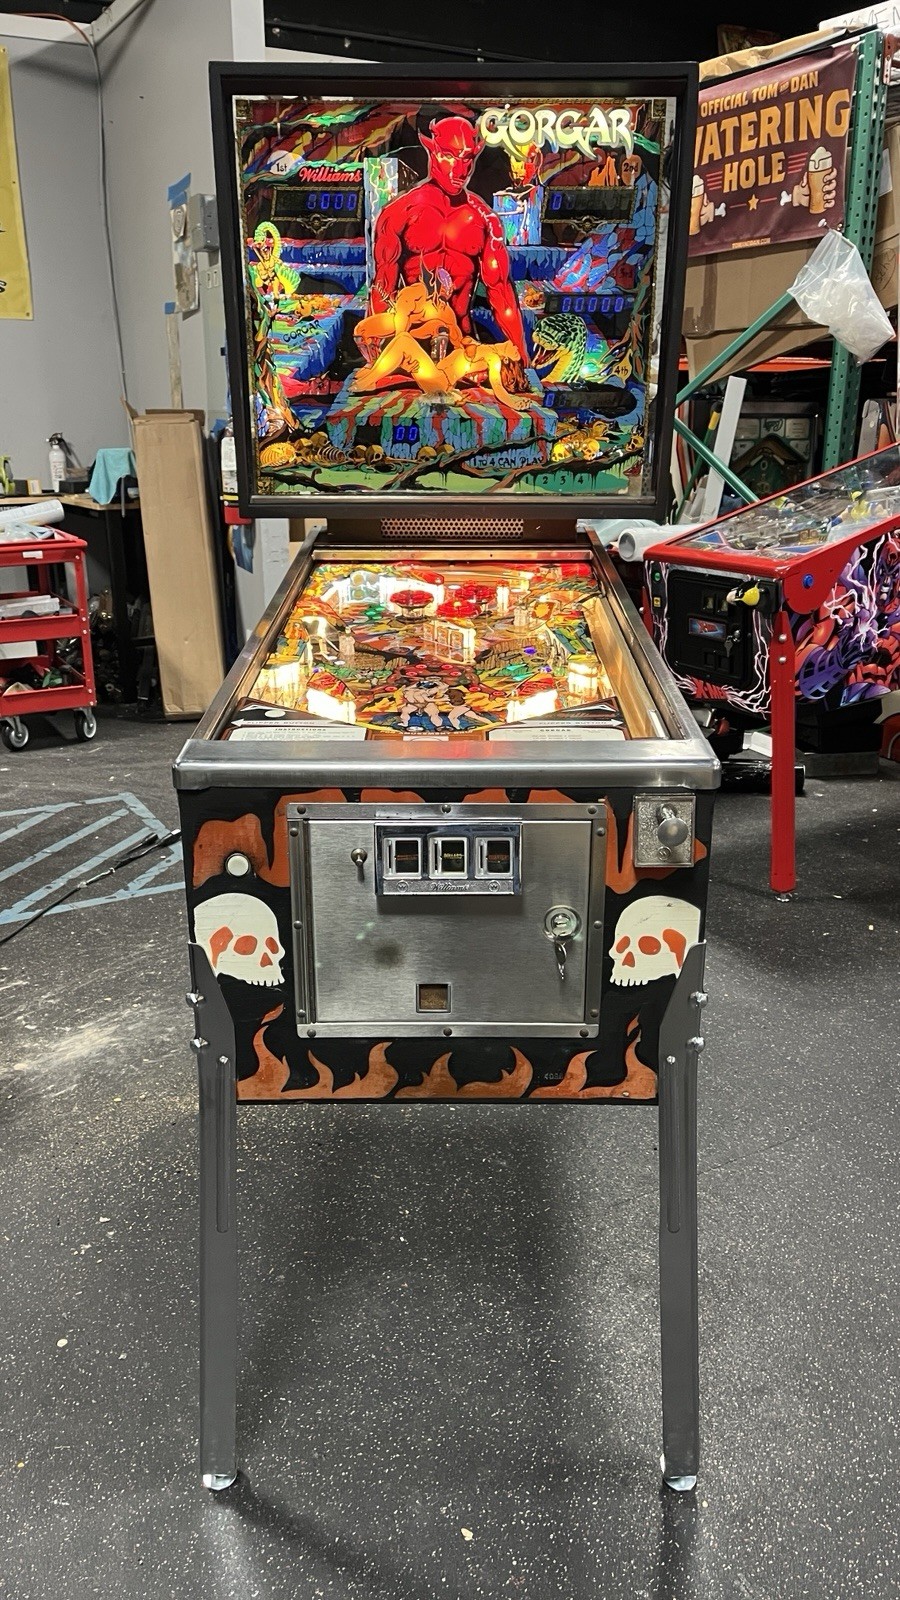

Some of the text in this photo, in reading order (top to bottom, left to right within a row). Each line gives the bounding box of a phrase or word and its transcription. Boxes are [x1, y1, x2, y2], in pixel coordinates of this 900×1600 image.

[700, 91, 749, 118] OFFICIAL
[752, 82, 779, 103] TOM
[790, 71, 818, 93] DAN
[479, 104, 634, 159] GORGAR
[276, 163, 287, 172] 1st
[623, 162, 639, 172] 2nd
[723, 151, 786, 193] HOLE
[299, 166, 362, 182] Williams
[614, 364, 629, 374] 4th
[489, 458, 496, 466] 4
[498, 457, 516, 467] CAN
[521, 456, 544, 466] PLAY
[543, 475, 549, 485] 2
[560, 475, 566, 485] 3
[577, 475, 584, 485] 4
